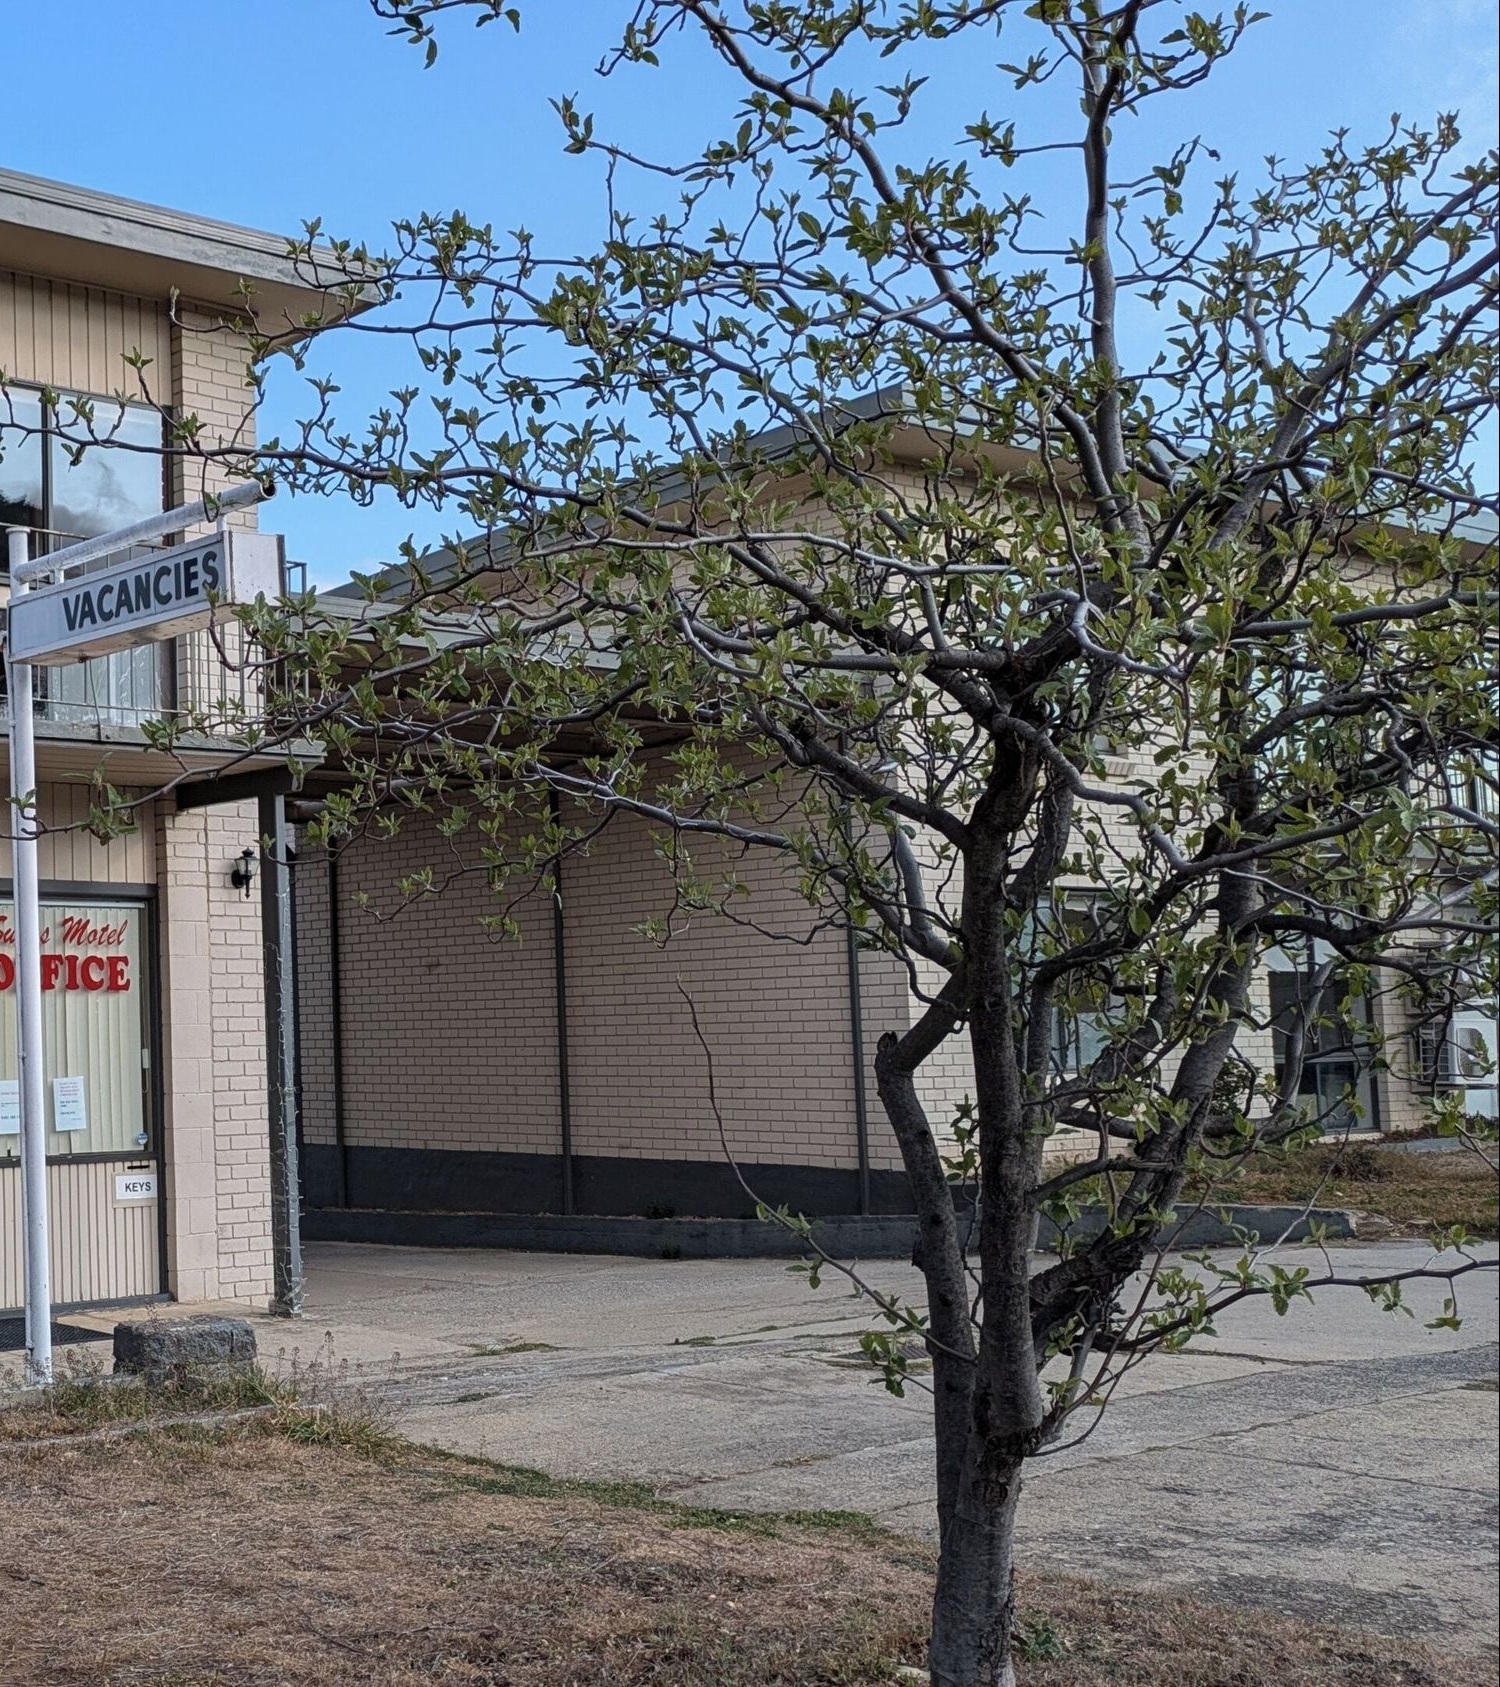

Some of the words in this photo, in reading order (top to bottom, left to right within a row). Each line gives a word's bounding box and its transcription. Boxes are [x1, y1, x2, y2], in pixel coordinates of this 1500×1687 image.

[62, 551, 219, 632] VACANCIES
[61, 915, 128, 946] Motel
[124, 1181, 152, 1193] KEYS
